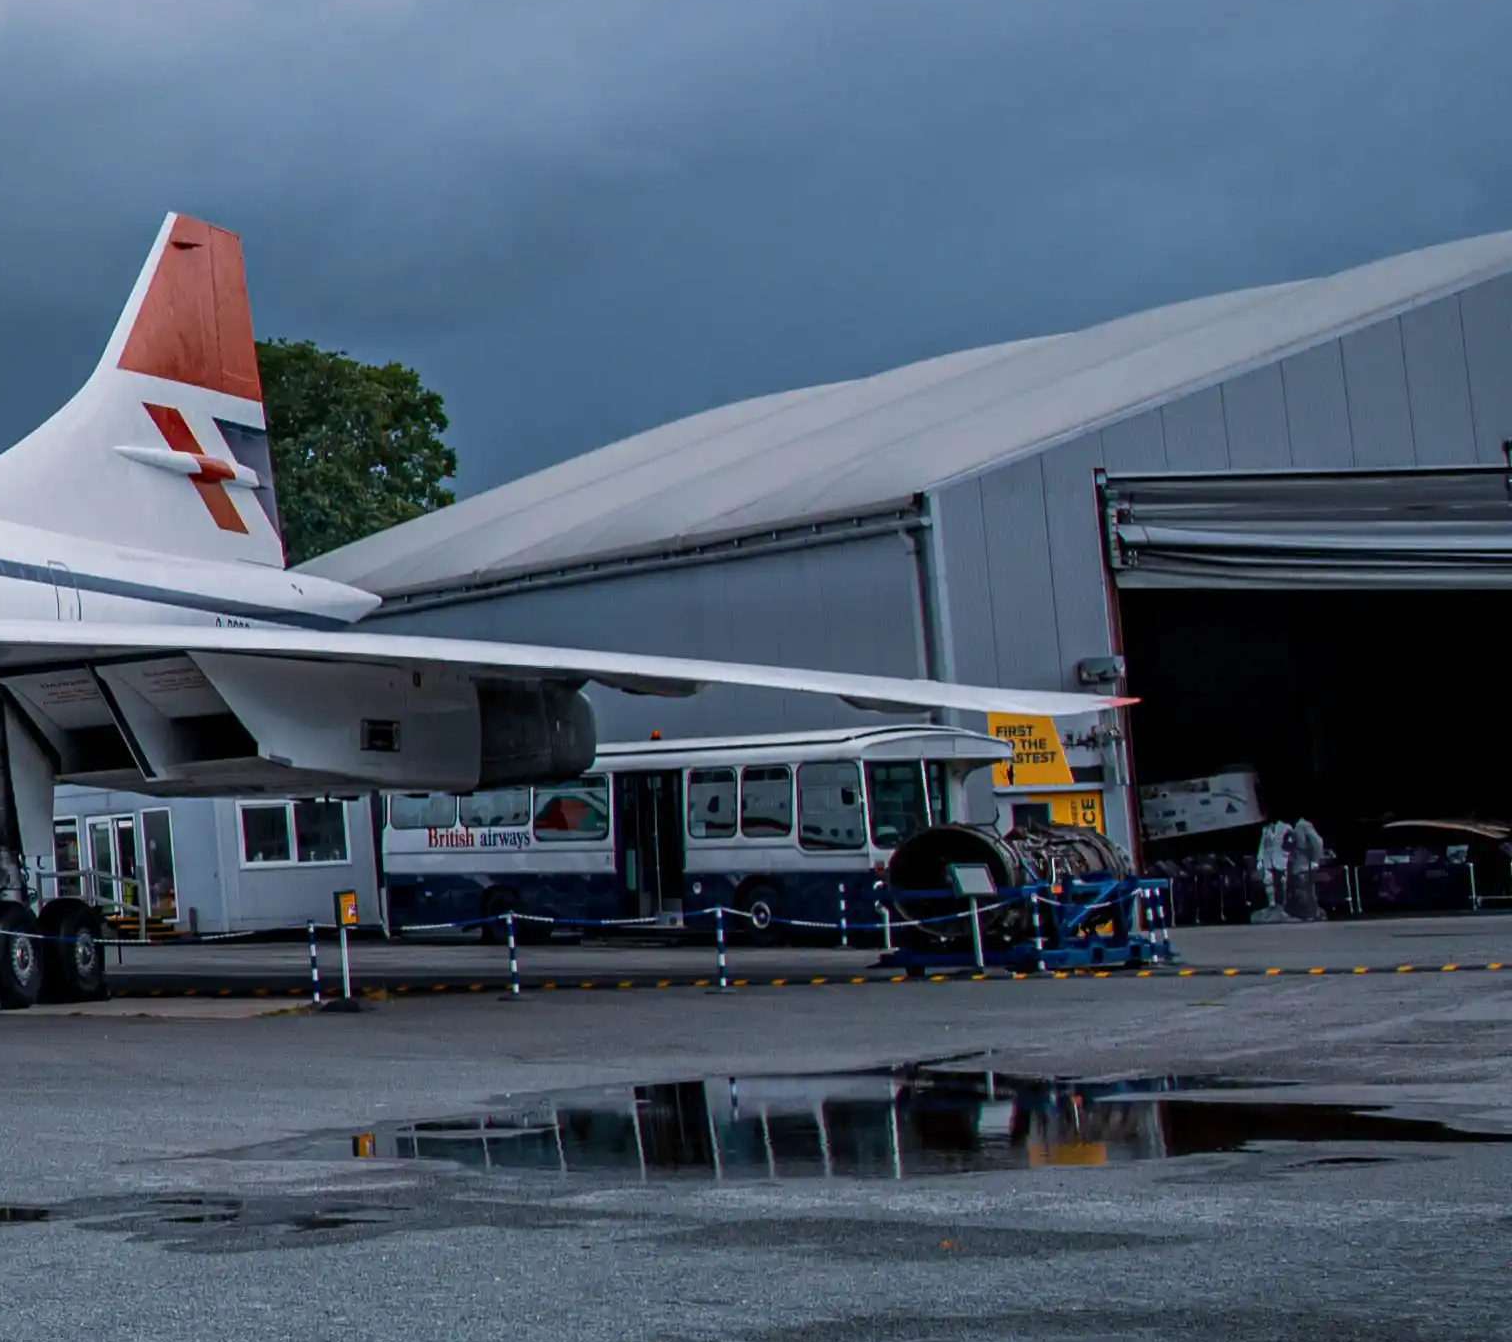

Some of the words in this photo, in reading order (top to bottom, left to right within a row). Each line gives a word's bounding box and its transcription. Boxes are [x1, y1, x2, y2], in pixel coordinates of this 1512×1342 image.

[995, 725, 1034, 737] FIRST
[1021, 738, 1047, 750] THE
[427, 825, 475, 848] British
[479, 828, 531, 849] airways
